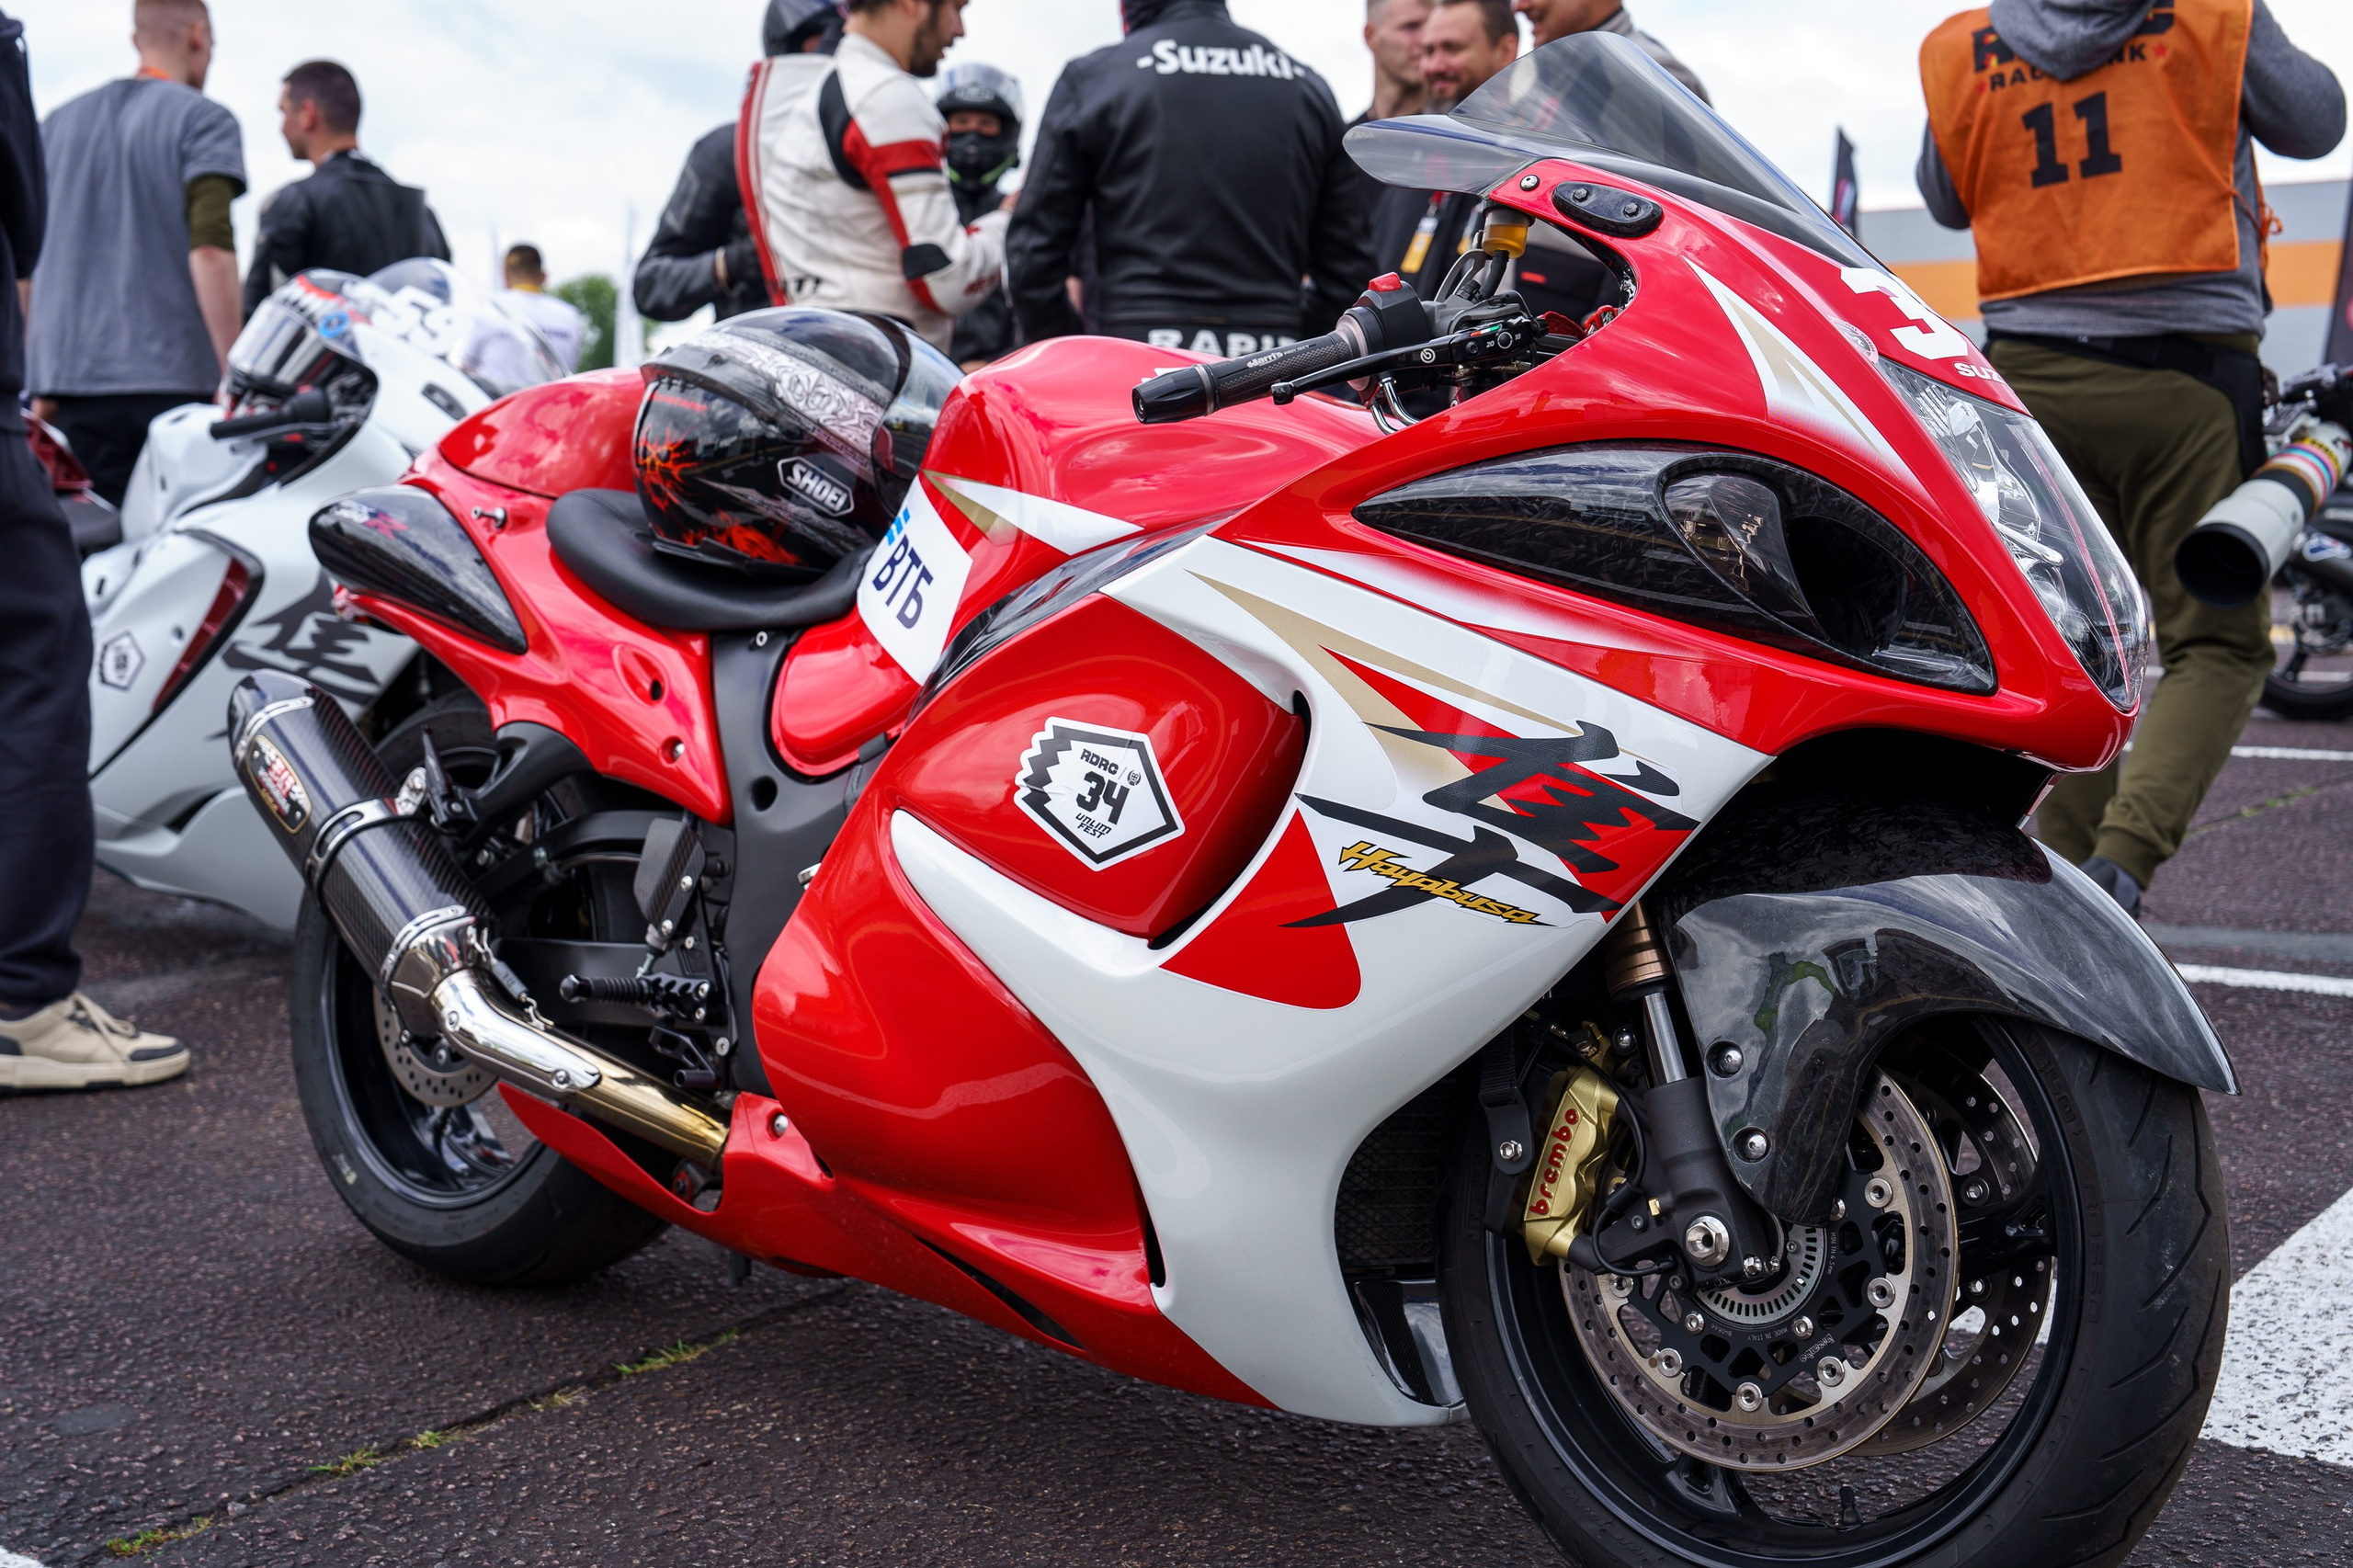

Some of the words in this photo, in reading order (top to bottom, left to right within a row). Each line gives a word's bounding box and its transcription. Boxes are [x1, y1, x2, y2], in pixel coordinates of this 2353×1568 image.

[2021, 91, 2122, 189] 11
[1953, 362, 2005, 383] SUZ
[786, 462, 847, 511] SHOEI
[871, 533, 934, 630] ВТБ
[1079, 748, 1120, 776] RDRC
[1075, 770, 1131, 825] 34
[1076, 823, 1106, 839] FEST
[1338, 840, 1558, 927] Hayabusa
[1529, 1108, 1580, 1216] brembo
[1773, 1326, 1789, 1338] MADE
[1799, 1333, 1835, 1363] brembo
